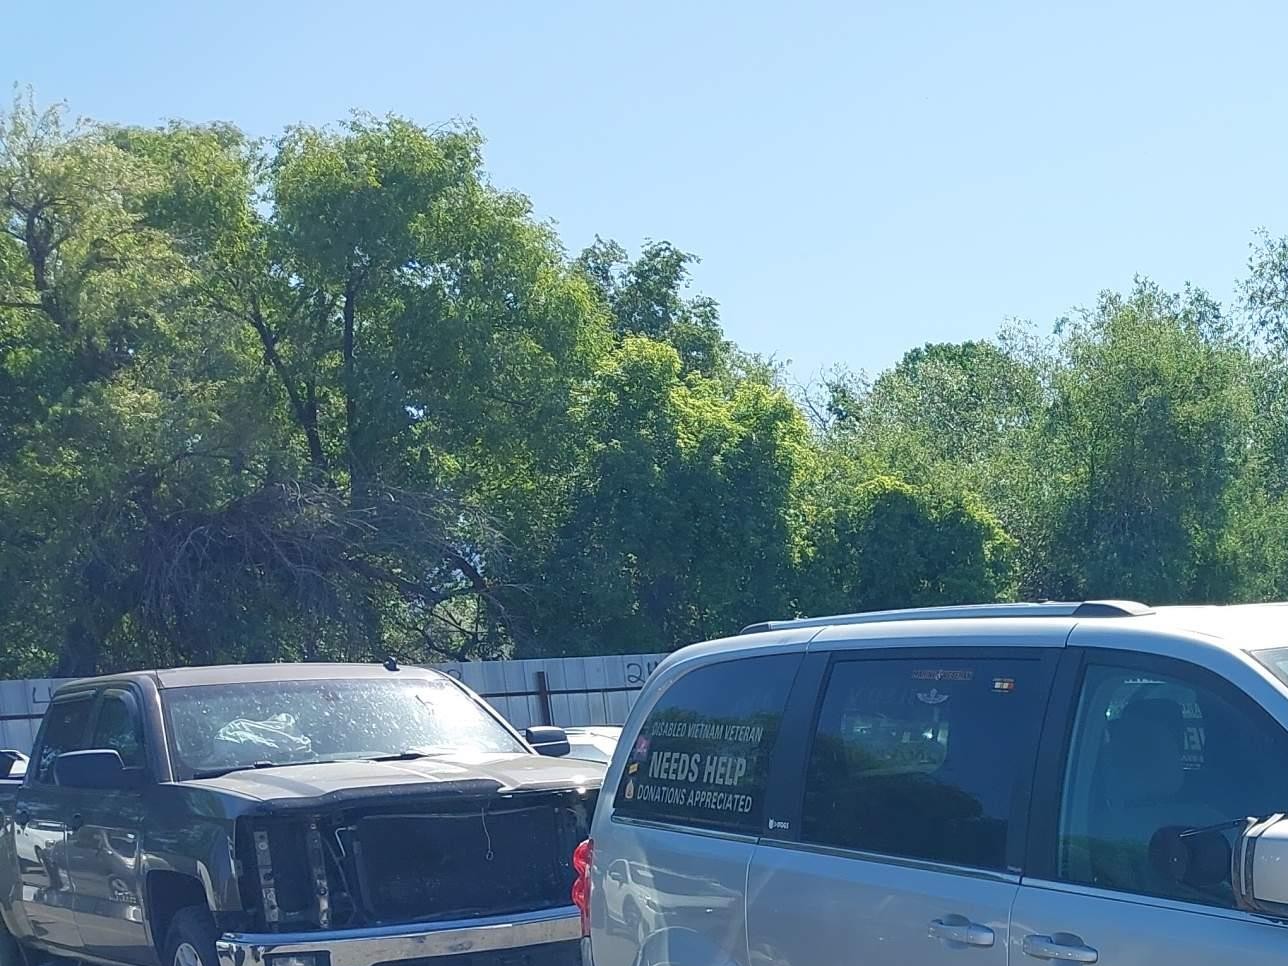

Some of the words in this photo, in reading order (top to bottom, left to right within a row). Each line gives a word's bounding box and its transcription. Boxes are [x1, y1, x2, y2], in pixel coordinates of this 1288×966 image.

[651, 721, 687, 738] DISABLED
[687, 723, 724, 740] VIETNAM
[724, 724, 764, 743] VETERAN
[649, 751, 701, 783] NEEDS
[703, 754, 747, 786] HELP
[636, 784, 687, 806] DONATIONS
[686, 789, 753, 813] APPRECIATED
